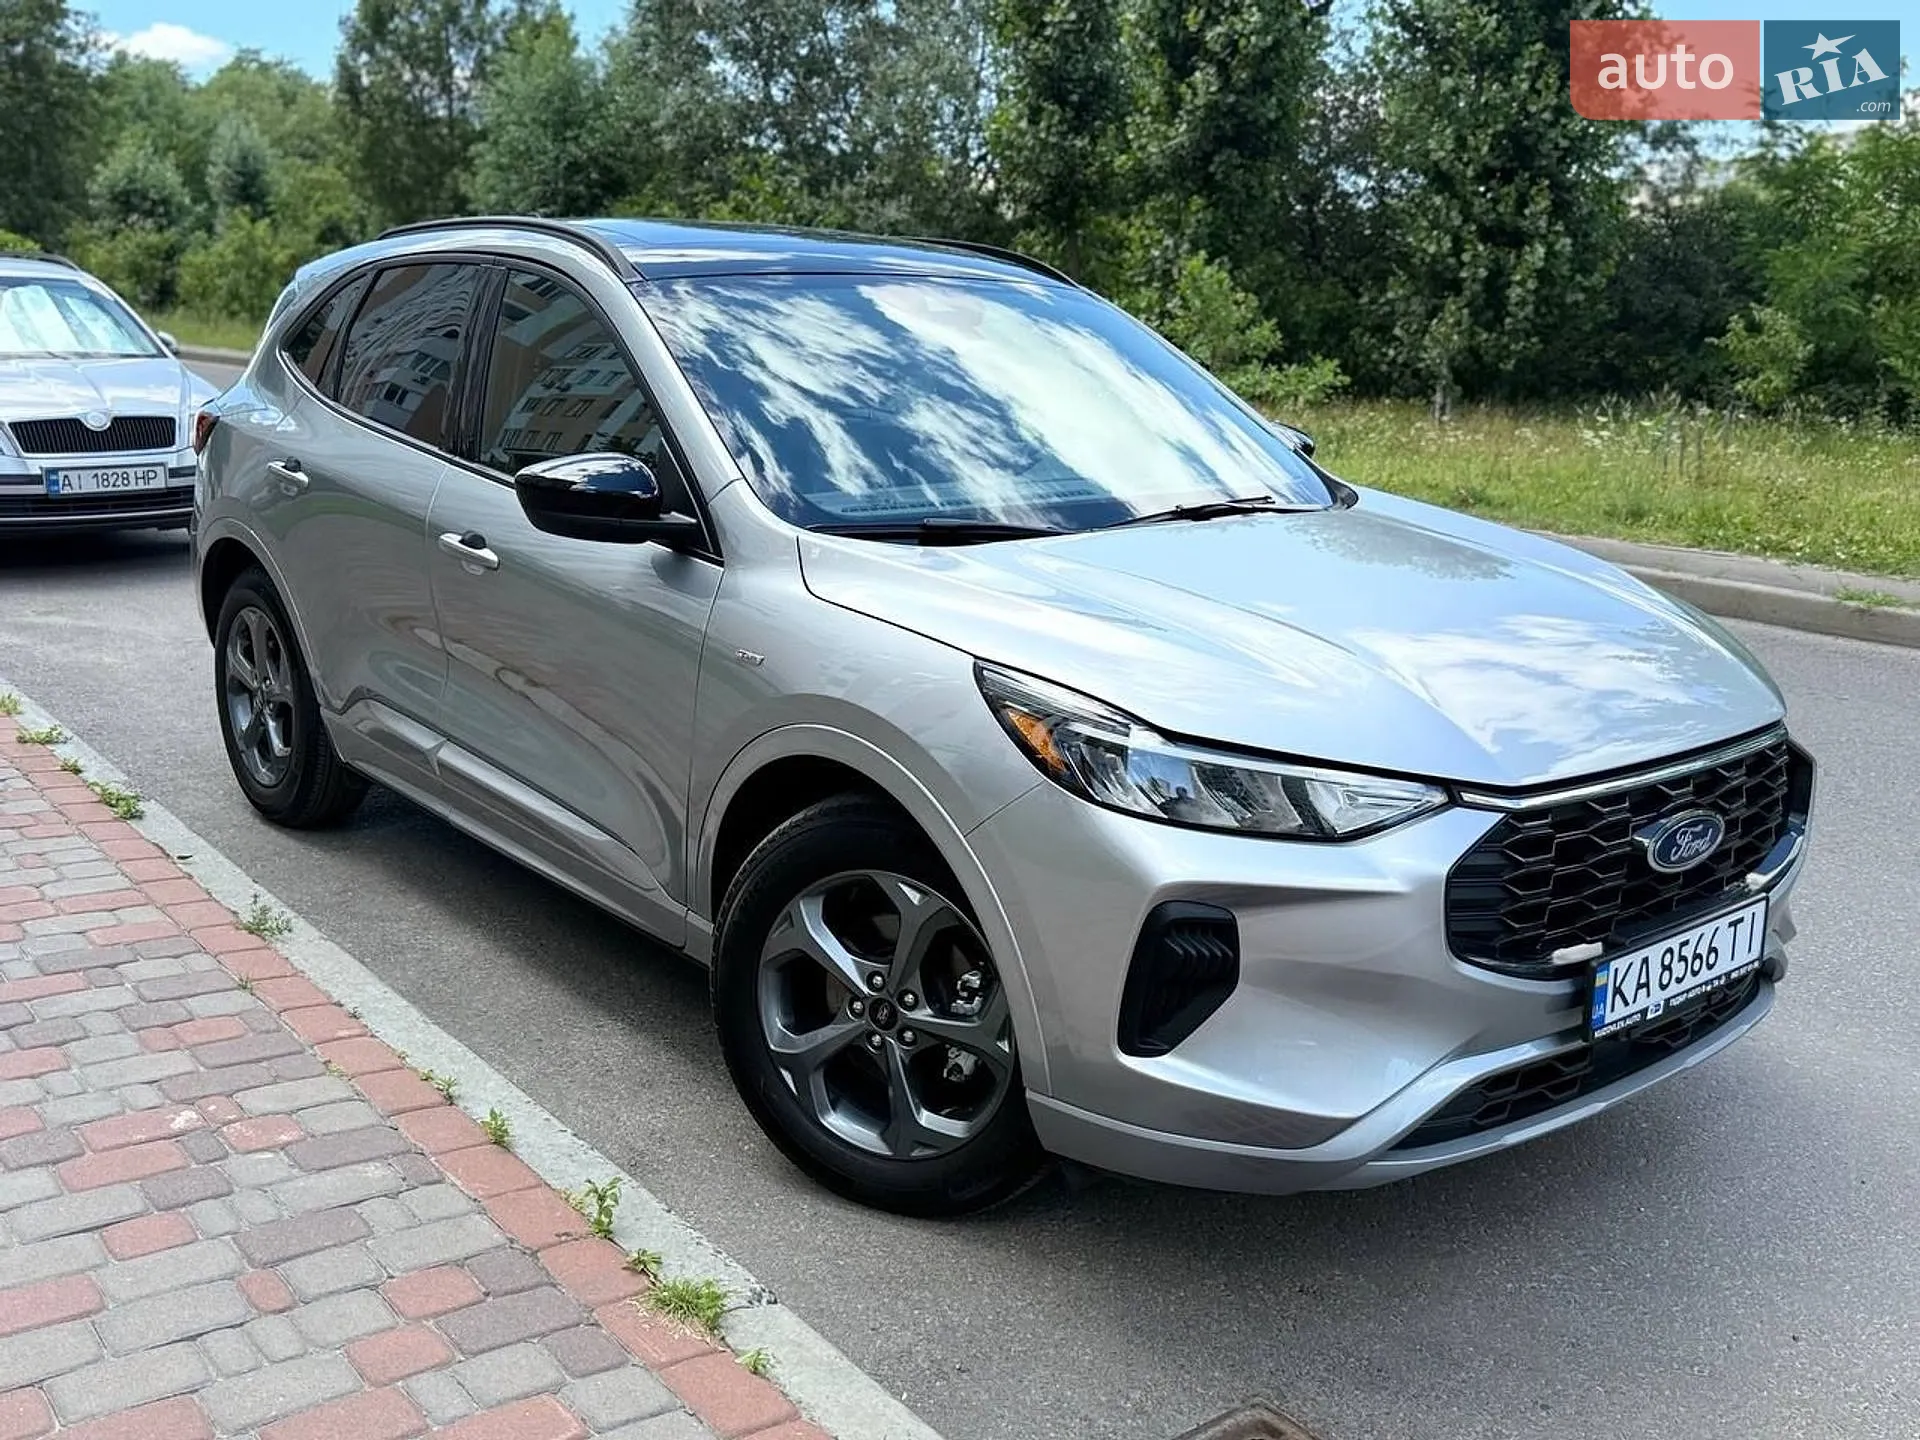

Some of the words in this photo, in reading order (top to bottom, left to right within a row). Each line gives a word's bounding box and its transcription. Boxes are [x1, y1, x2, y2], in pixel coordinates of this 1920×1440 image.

[91, 471, 131, 489] 1828
[134, 469, 158, 487] HP
[1670, 824, 1713, 861] Ford
[1610, 956, 1651, 1013] KA
[1658, 926, 1720, 992] 8566
[1728, 911, 1756, 961] TI
